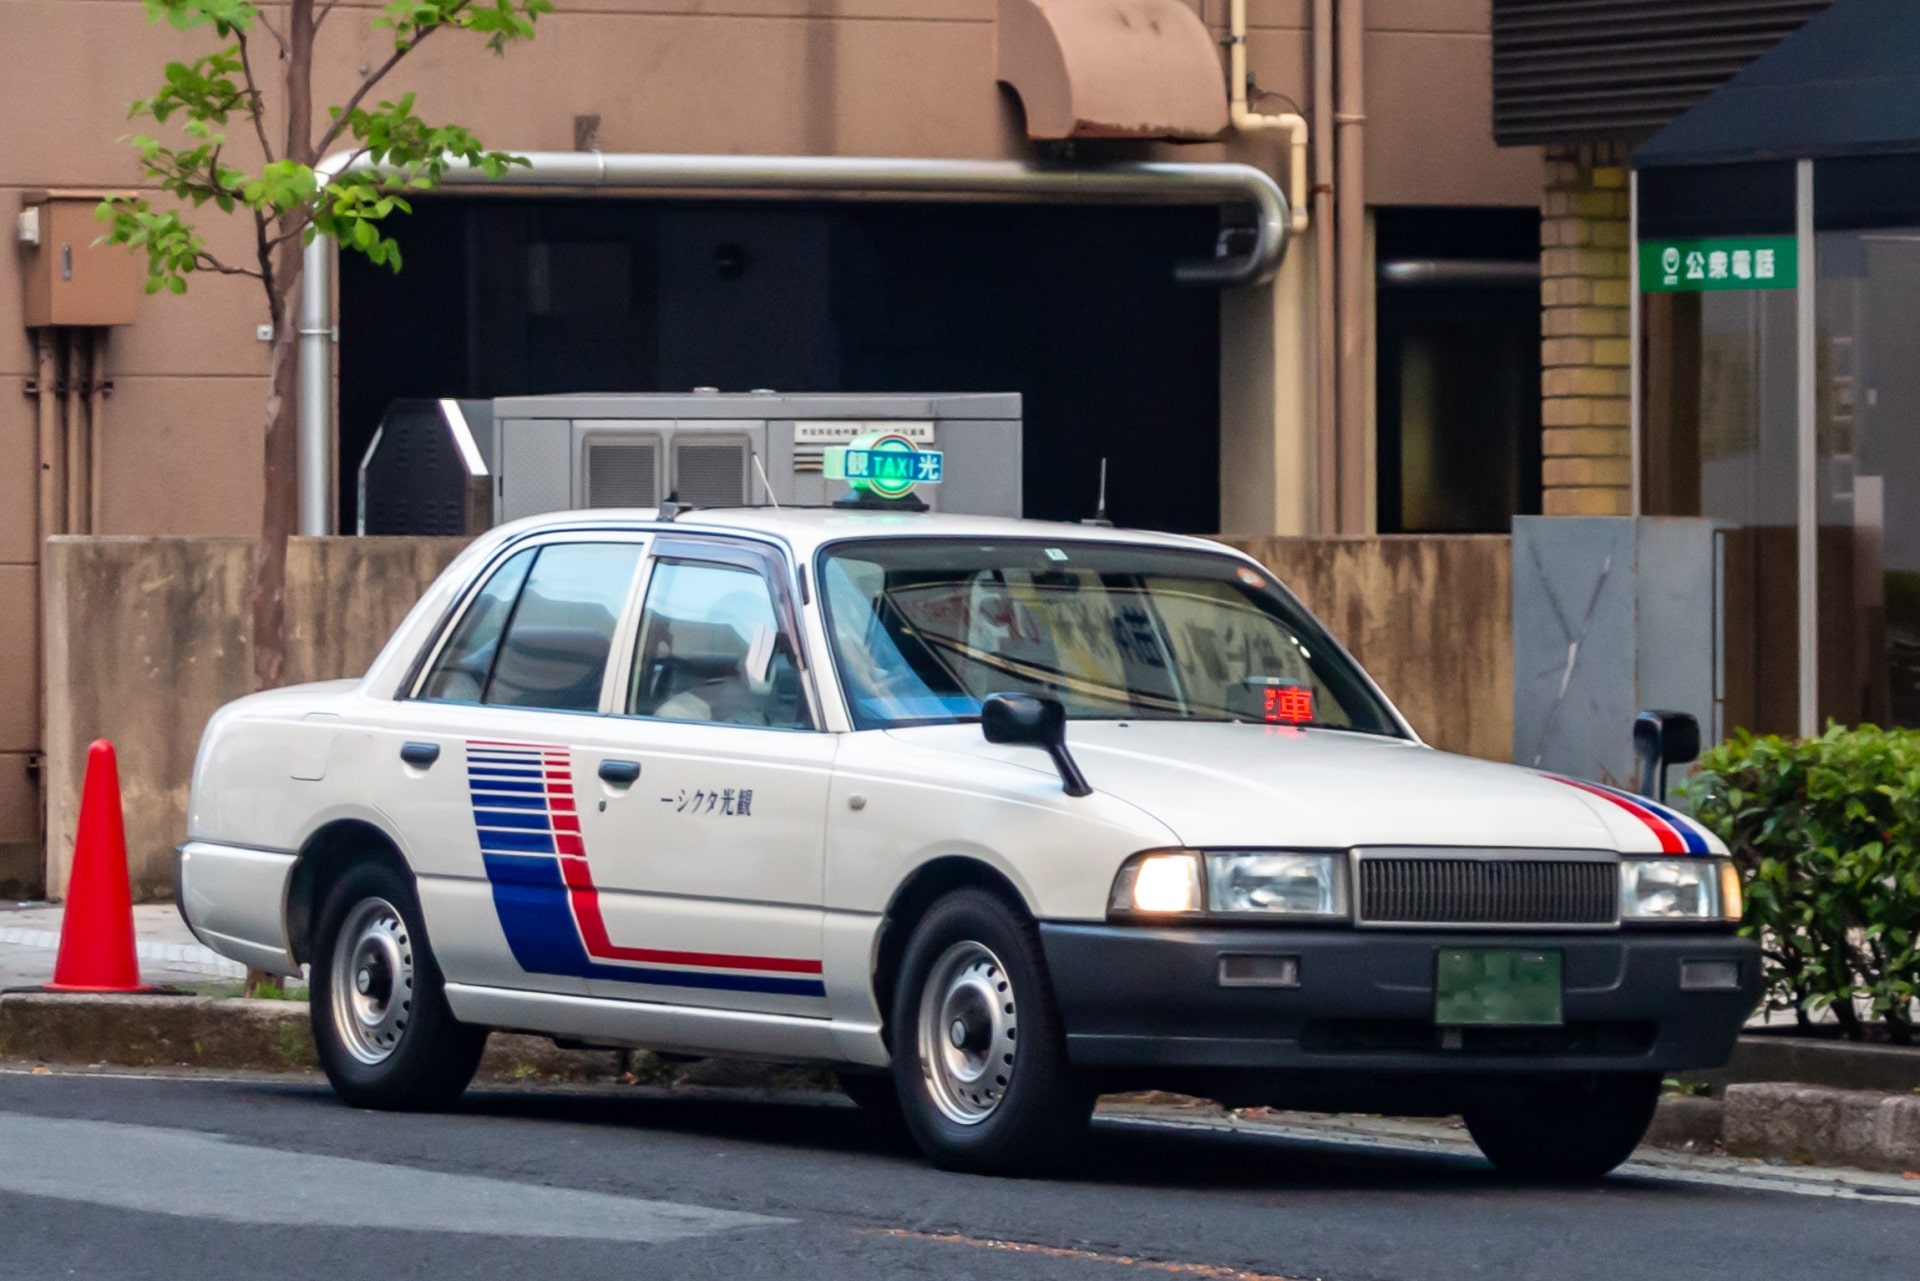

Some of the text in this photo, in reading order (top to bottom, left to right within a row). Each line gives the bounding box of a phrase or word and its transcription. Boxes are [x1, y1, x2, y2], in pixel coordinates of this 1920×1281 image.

[1686, 249, 1775, 279] 公衆電話
[873, 456, 915, 477] TAXI
[918, 454, 939, 480] 光
